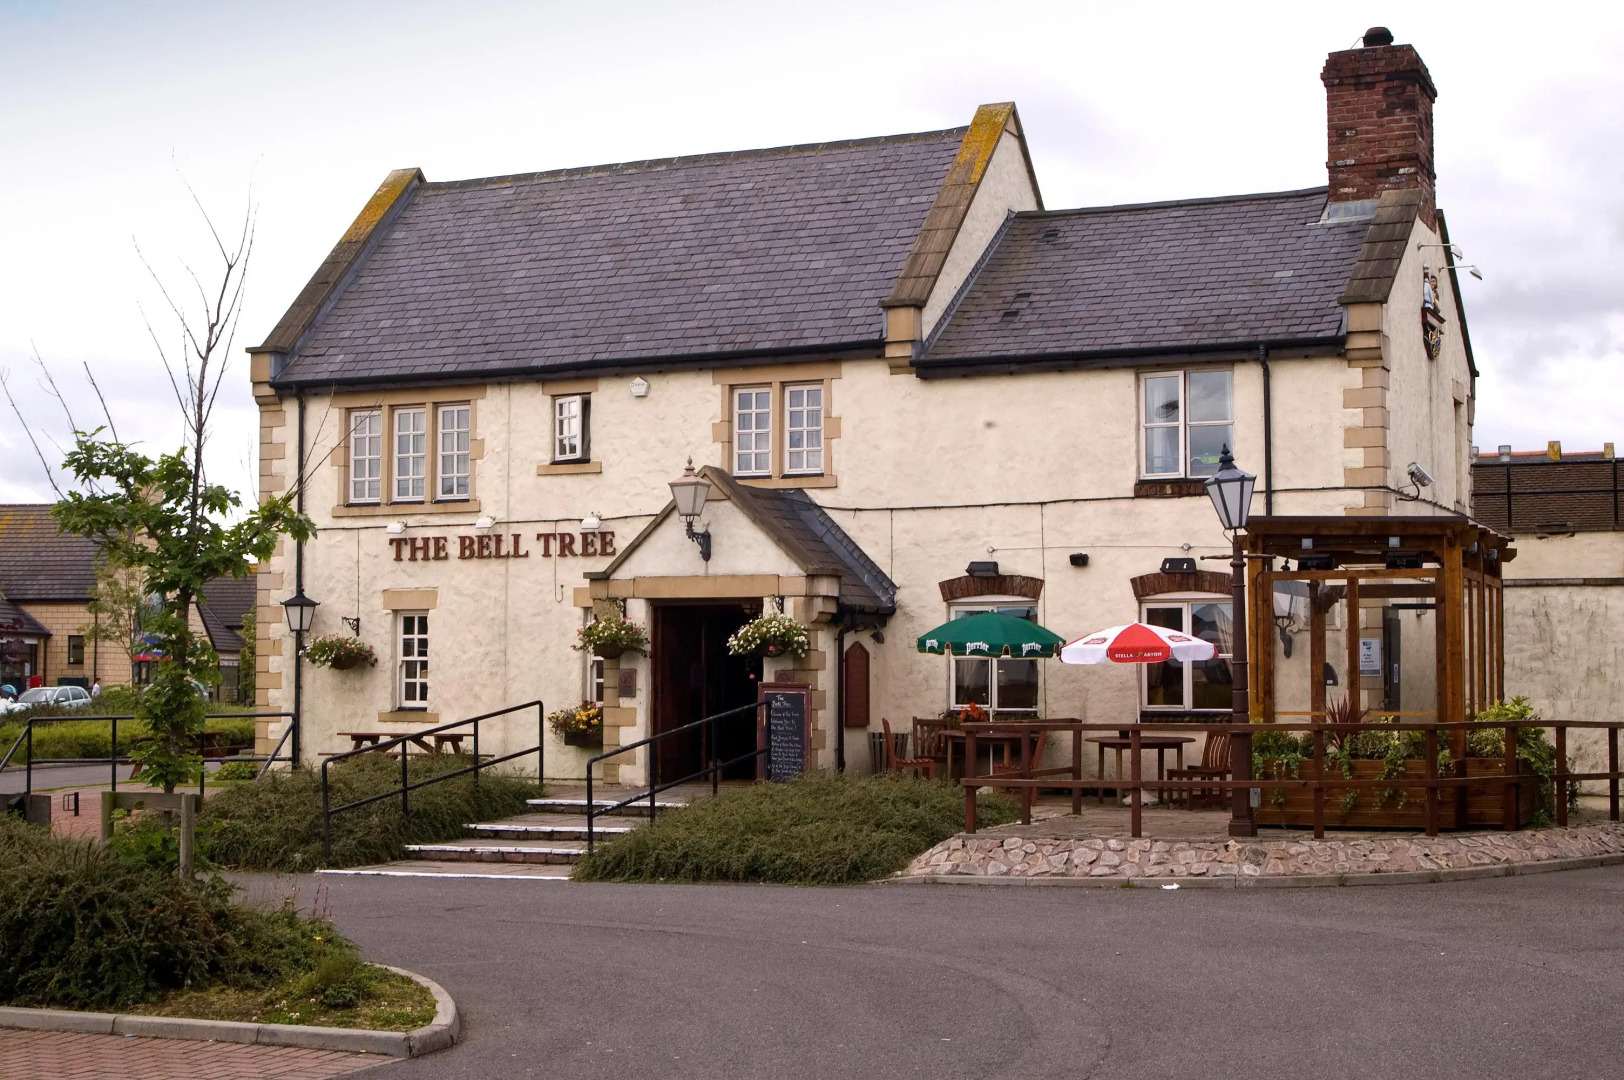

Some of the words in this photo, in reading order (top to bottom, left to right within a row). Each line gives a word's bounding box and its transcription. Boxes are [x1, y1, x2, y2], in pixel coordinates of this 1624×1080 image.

[389, 536, 448, 561] THE
[458, 533, 529, 559] BELL
[537, 531, 617, 557] TREE
